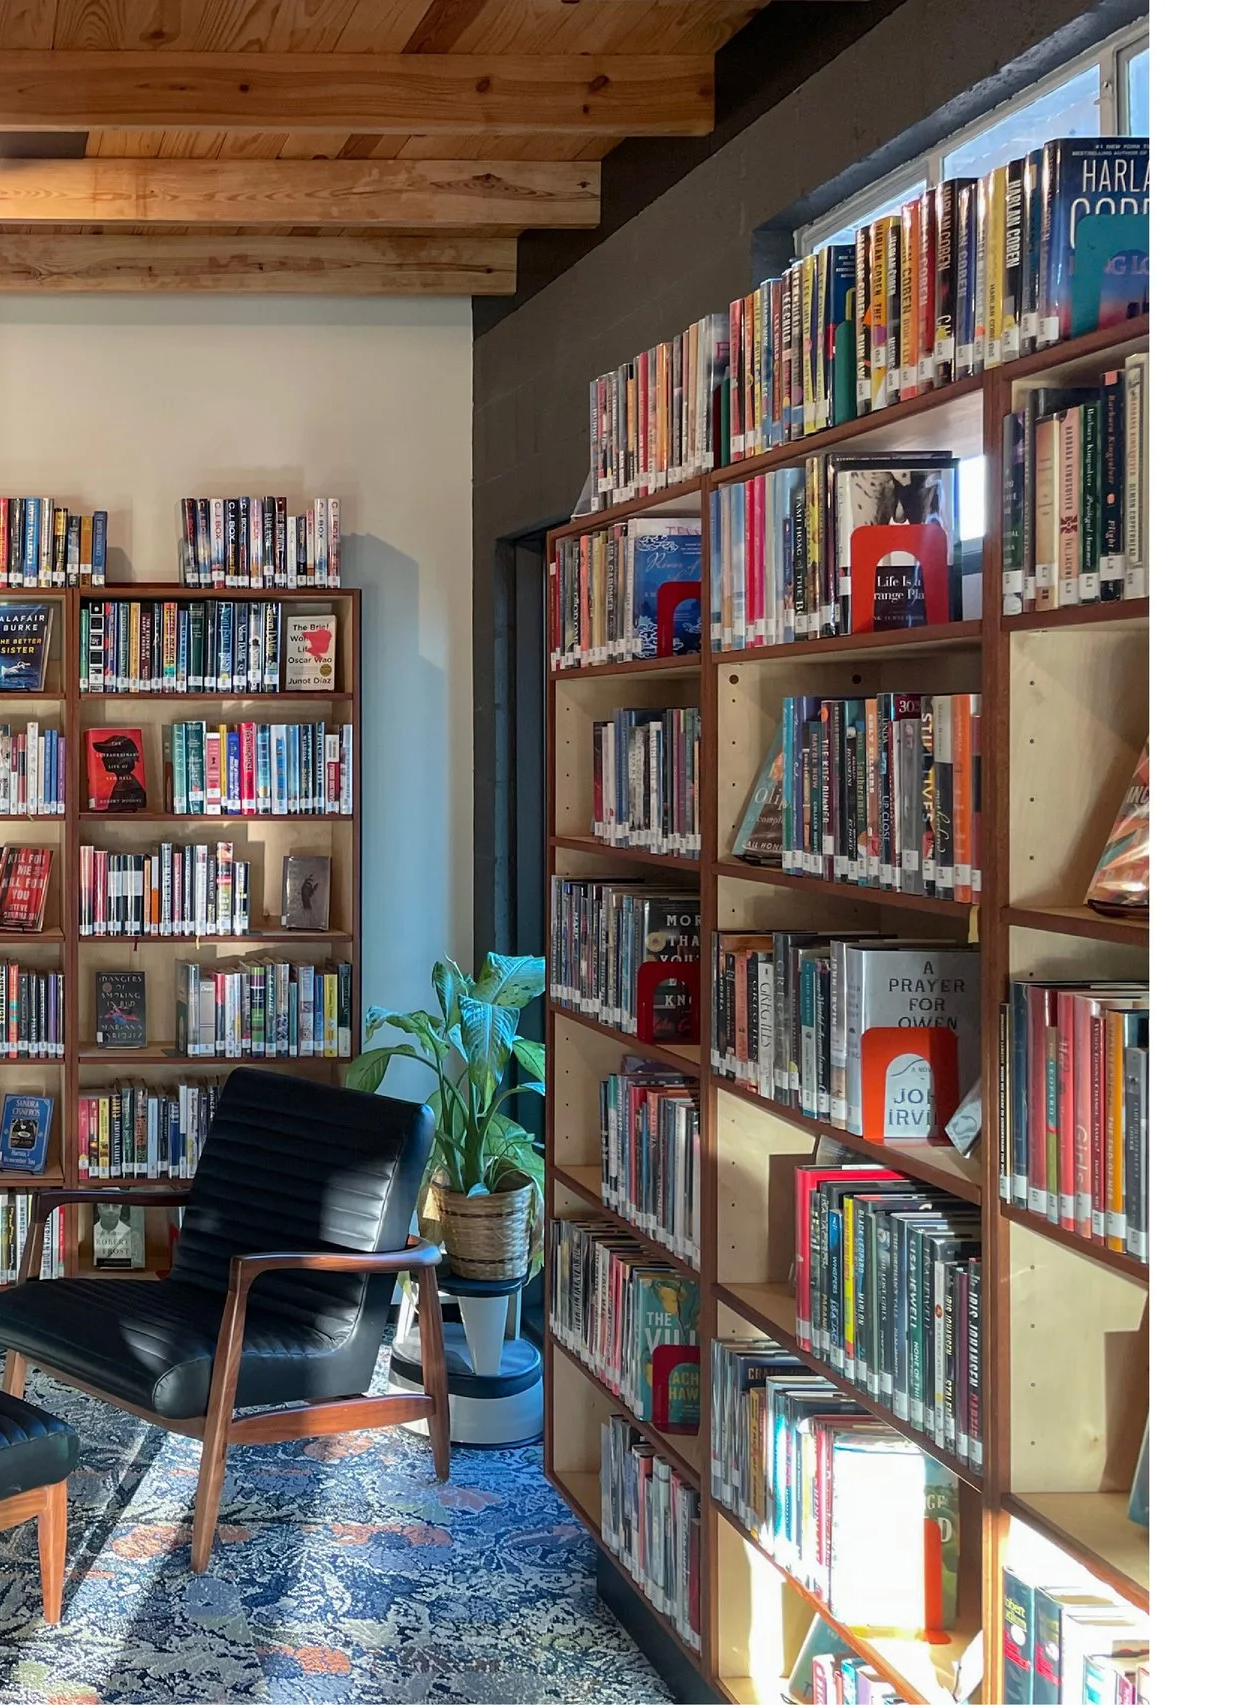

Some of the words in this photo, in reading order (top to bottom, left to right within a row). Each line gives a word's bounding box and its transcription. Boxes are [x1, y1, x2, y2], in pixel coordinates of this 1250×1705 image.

[940, 186, 951, 230] HARLAN
[1006, 179, 1021, 227] HARLAN
[874, 225, 883, 262] HARLAN
[888, 235, 897, 267] HARLAN
[937, 231, 950, 271] COBEN
[1006, 229, 1020, 268] COBEN
[873, 264, 883, 296] COBEN
[888, 269, 896, 295] COBEN
[958, 249, 967, 297] COBEN
[782, 292, 790, 311] LEE
[902, 267, 912, 314] COBEN
[874, 303, 883, 320] THE
[782, 313, 791, 342] CHILD
[1086, 408, 1094, 441] Barbara
[1107, 395, 1115, 432] Barbara
[1085, 444, 1094, 487] Kingsolver
[1106, 436, 1116, 485] Kingsolver
[1129, 484, 1137, 509] DEMON
[1084, 494, 1094, 532] Prodigal
[1106, 519, 1116, 547] Flight
[1129, 511, 1137, 557] COPPERHEAD
[1086, 535, 1094, 567] Summer
[877, 575, 899, 587] Life
[901, 576, 912, 587] Is
[310, 623, 329, 631] Brief
[1, 646, 34, 654] SISTER
[288, 656, 312, 664] Oscar
[313, 656, 332, 664] Wao
[288, 677, 311, 685] Junot
[882, 795, 889, 811] UP
[922, 771, 933, 822] LIVES
[8, 852, 26, 864] KILL
[29, 853, 45, 864] FOR
[17, 865, 31, 876] ME
[12, 890, 30, 901] YOU
[25, 878, 43, 888] FOR
[923, 961, 934, 974] A
[888, 978, 965, 992] PRAYER
[760, 983, 772, 1020] GREG
[909, 998, 945, 1012] FOR
[760, 1023, 772, 1048] ILES
[898, 1017, 957, 1029] OWEN
[12, 1108, 40, 1116] CISNEROS
[15, 1100, 39, 1108] SANDRA
[1076, 1125, 1088, 1183] Girls
[909, 1275, 917, 1329] JEWELL
[969, 1291, 977, 1317] IRIS
[646, 1312, 671, 1326] THE
[969, 1320, 978, 1387] JOHANSEN
